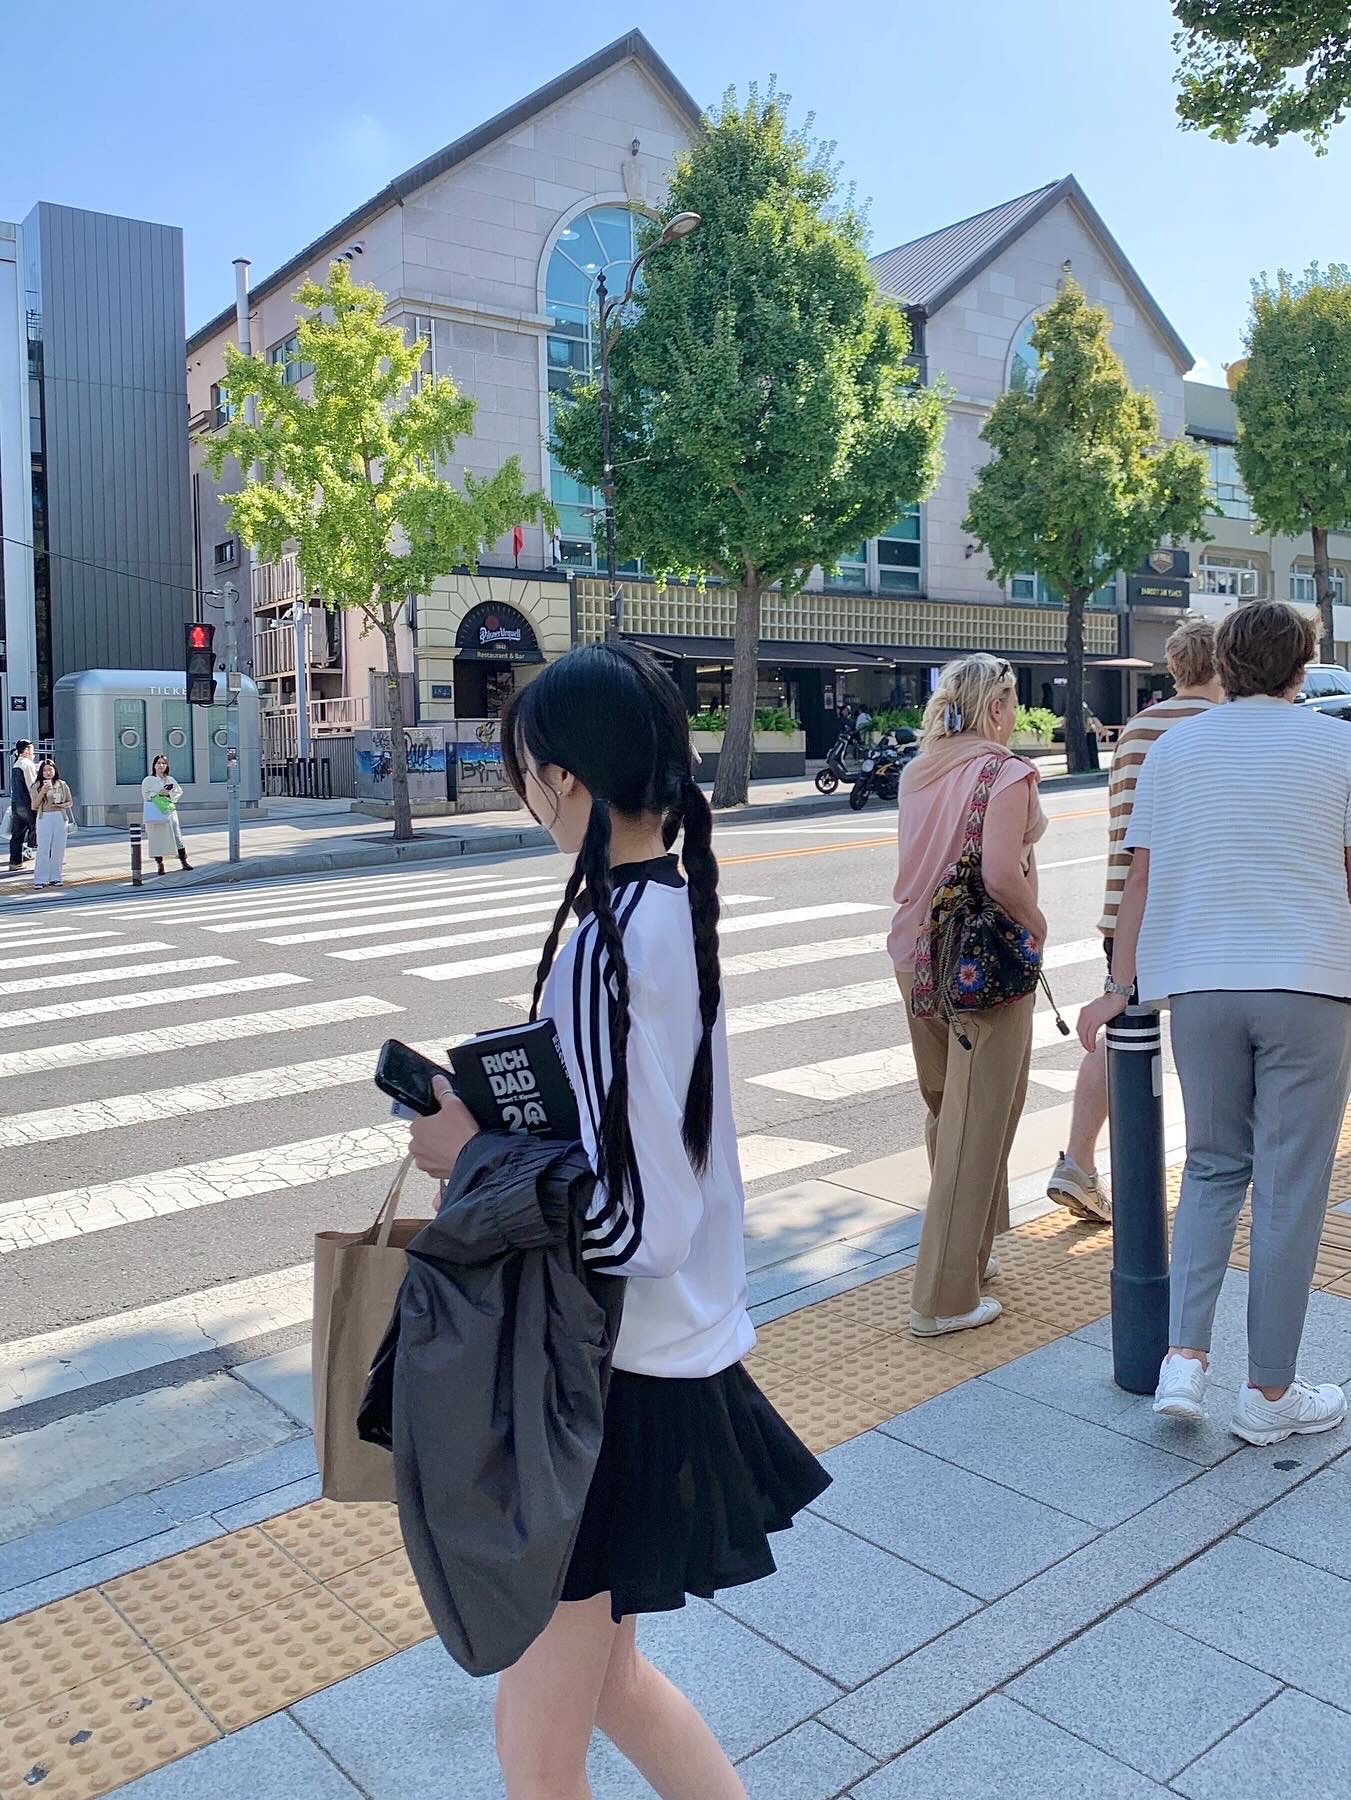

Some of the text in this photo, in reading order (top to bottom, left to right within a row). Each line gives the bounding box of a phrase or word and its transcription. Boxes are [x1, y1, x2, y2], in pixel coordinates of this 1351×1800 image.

[479, 627, 521, 644] Pilsner Urquell
[476, 651, 509, 659] Restaurant
[481, 1048, 529, 1075] RICH
[488, 1069, 536, 1097] DAD
